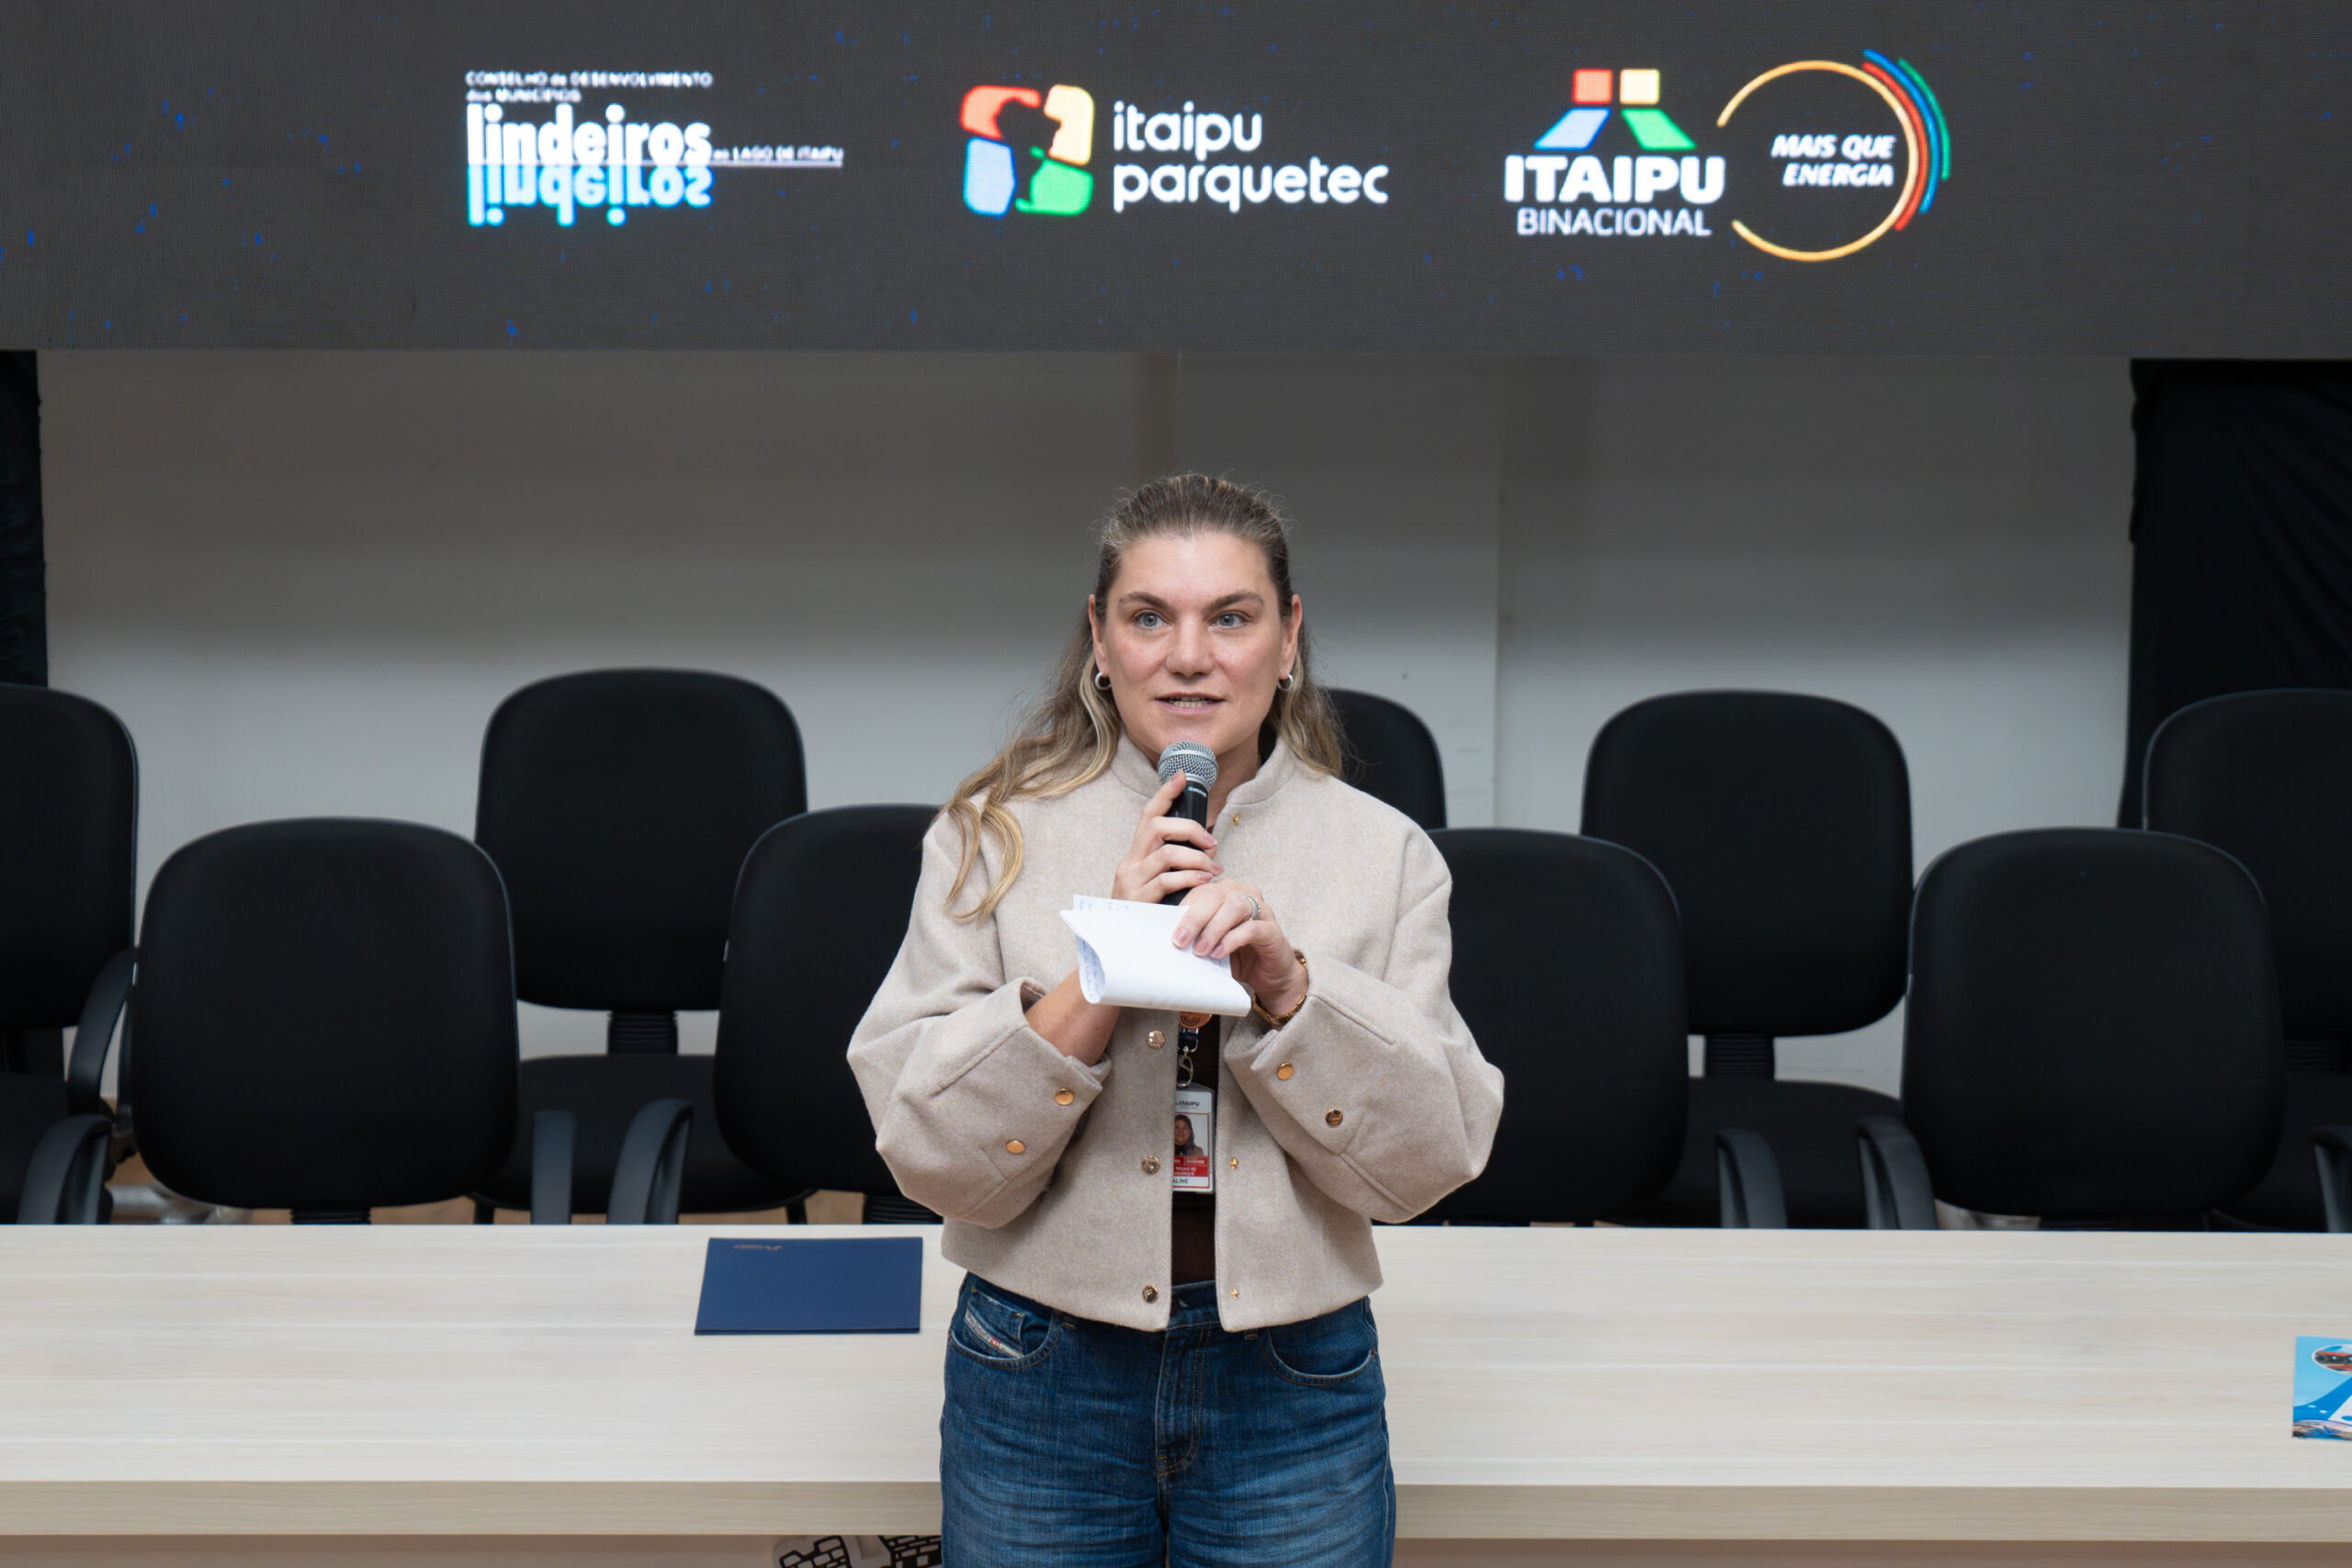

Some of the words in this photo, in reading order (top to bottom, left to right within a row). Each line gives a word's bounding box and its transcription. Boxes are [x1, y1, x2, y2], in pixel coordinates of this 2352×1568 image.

[467, 103, 712, 165] lindeiros
[1113, 100, 1263, 162] itaipu
[1770, 133, 1838, 159] MAIS
[1841, 134, 1896, 161] QUE
[1113, 155, 1389, 213] parquetec
[1504, 154, 1726, 204] ITAIPU
[1782, 162, 1895, 187] ENERGIA
[1516, 207, 1713, 237] BINACIONAL
